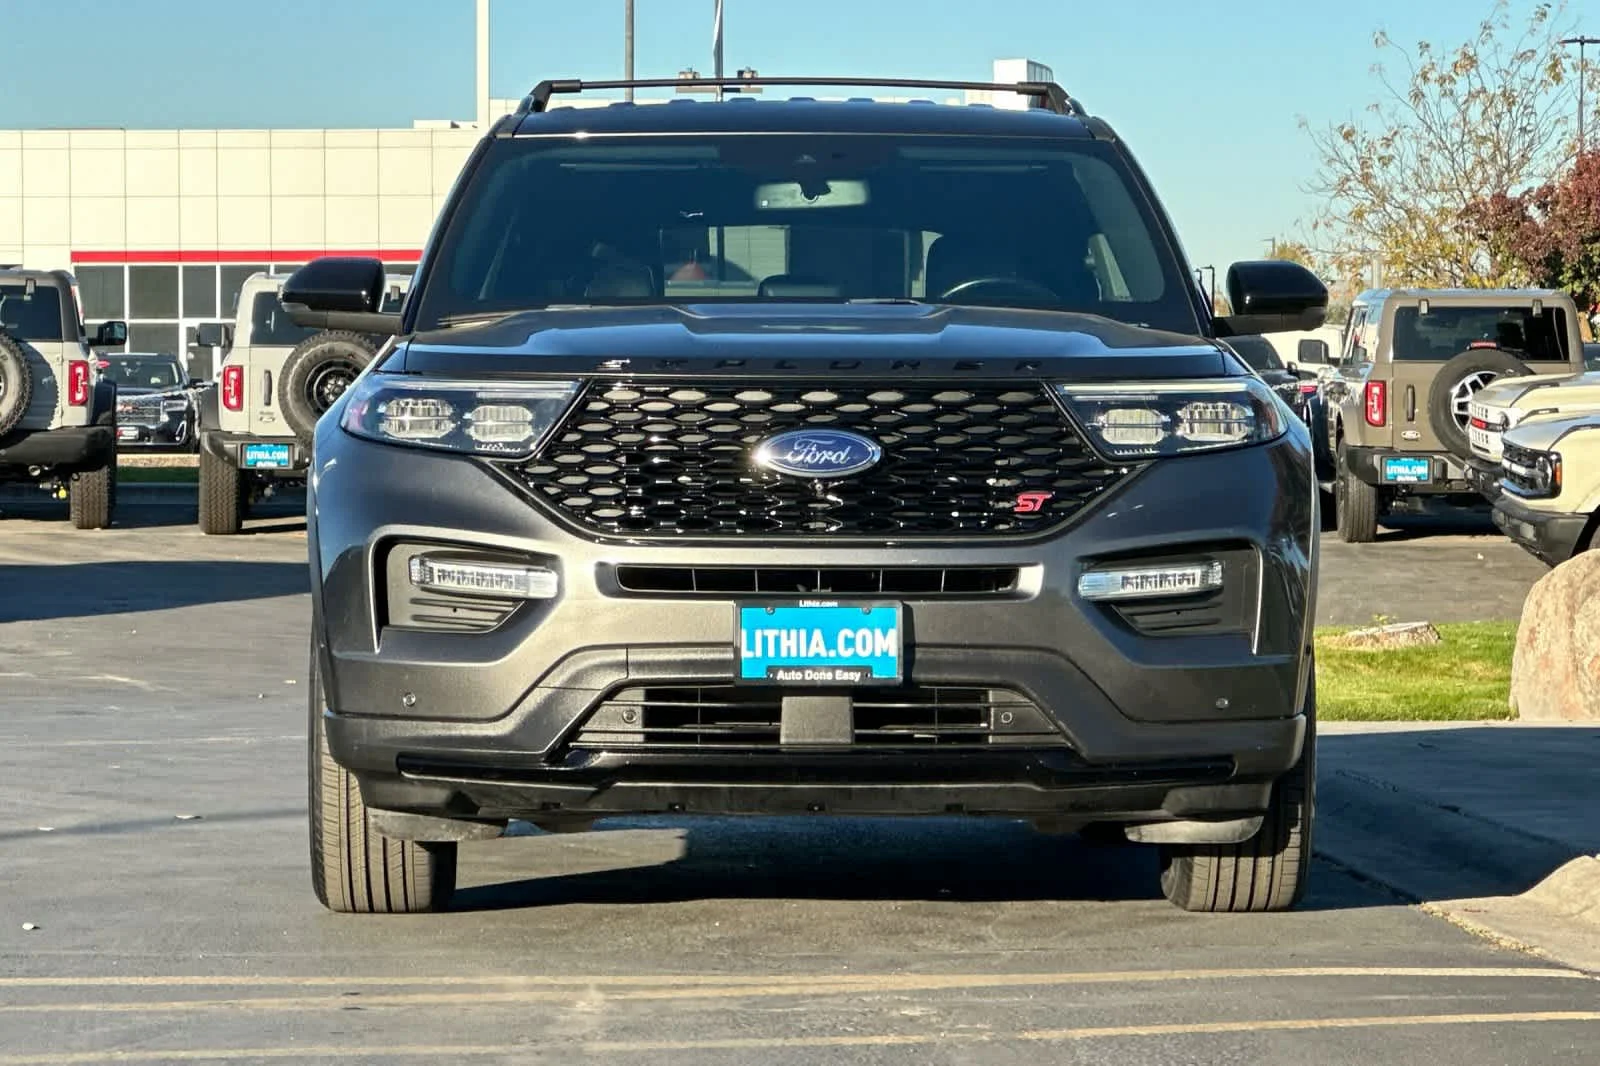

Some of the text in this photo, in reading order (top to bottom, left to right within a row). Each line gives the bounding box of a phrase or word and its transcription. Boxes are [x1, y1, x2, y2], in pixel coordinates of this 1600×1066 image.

[784, 438, 851, 464] Ford
[1014, 493, 1052, 512] ST
[799, 599, 838, 608] Lithia.com
[741, 628, 897, 659] LITHIA.COM
[776, 669, 861, 682] Auto Done Easy
